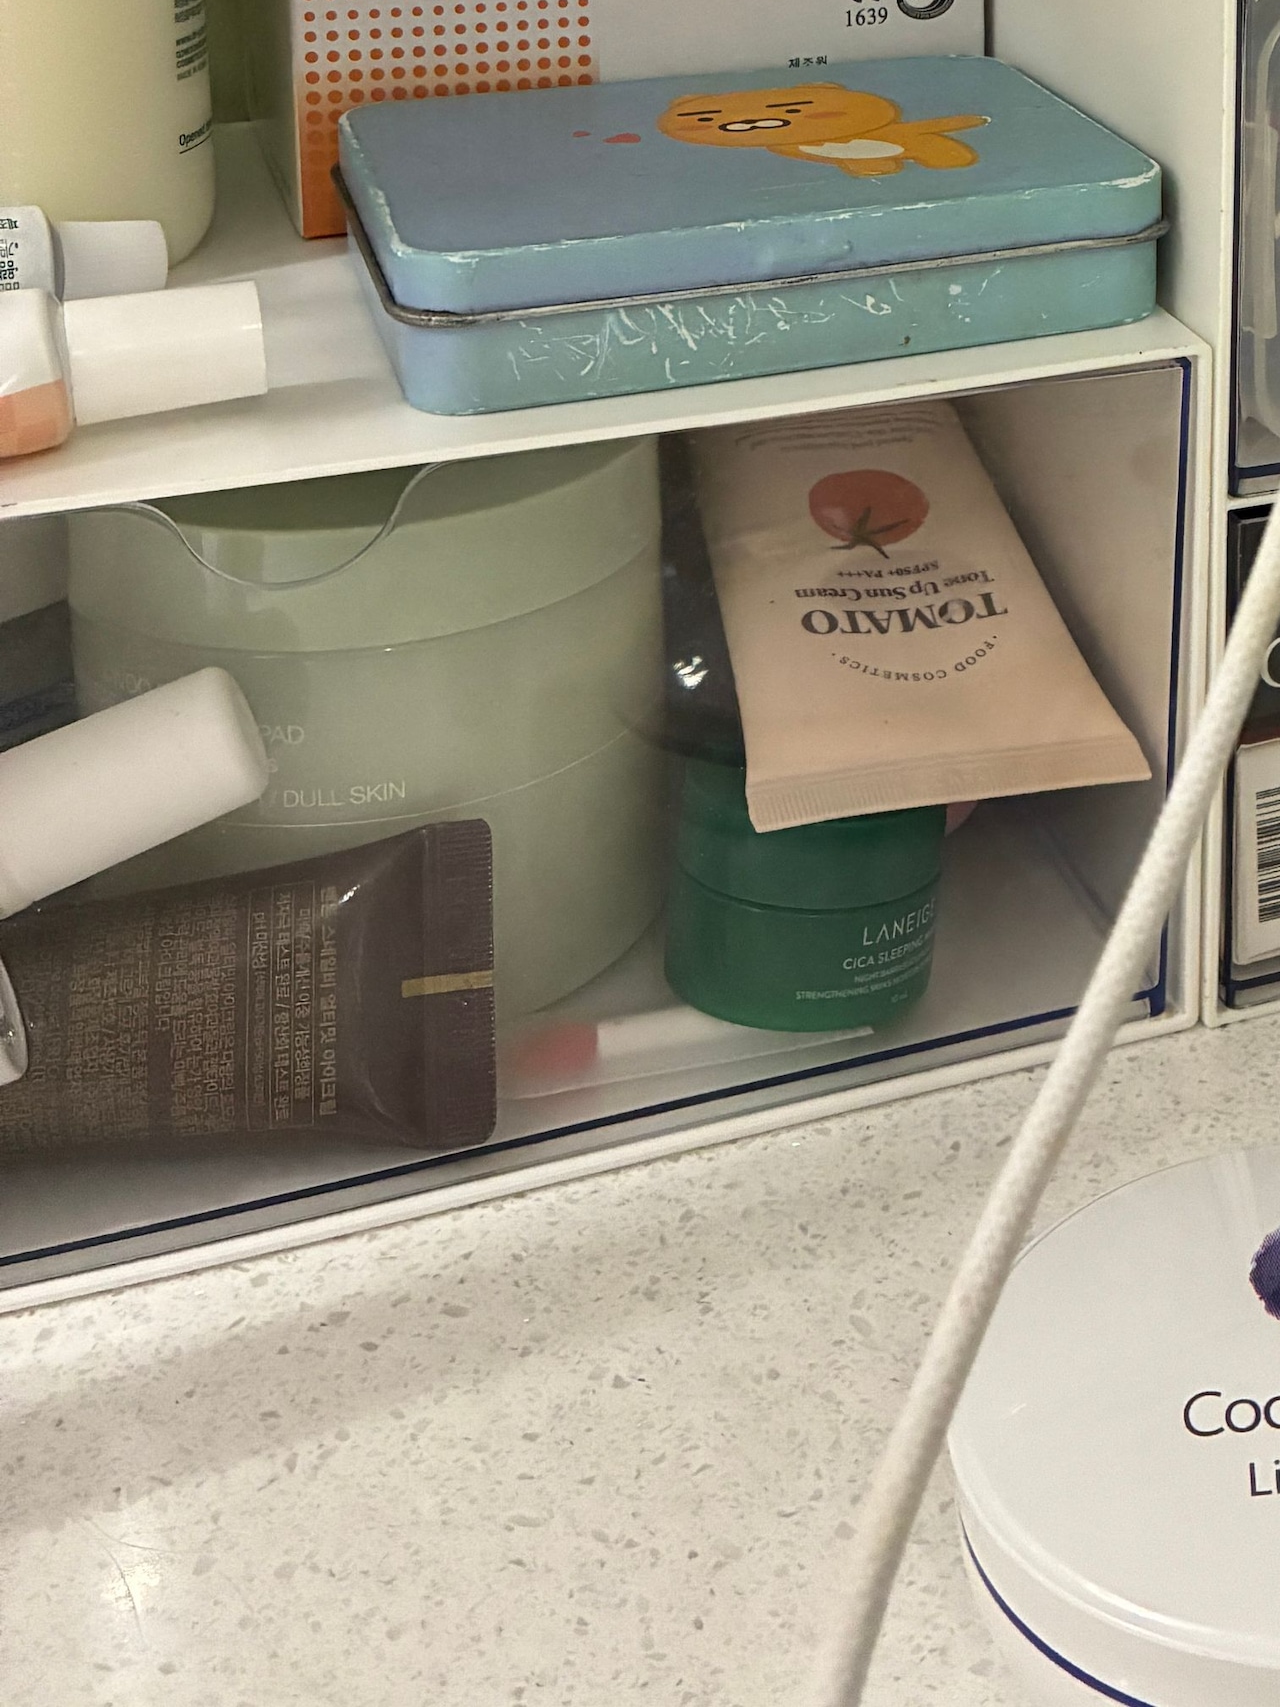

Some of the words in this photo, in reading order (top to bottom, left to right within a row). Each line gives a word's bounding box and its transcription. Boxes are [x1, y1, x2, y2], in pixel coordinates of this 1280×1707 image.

[845, 7, 888, 27] 1639
[837, 569, 883, 578] PA+++
[887, 560, 939, 577] SPF50+
[943, 570, 995, 587] Tone
[795, 588, 862, 601] Cream
[864, 587, 906, 600] Sun
[909, 581, 940, 596] Up
[801, 592, 1008, 635] TOMATO
[954, 641, 995, 672] FOOD
[839, 656, 947, 682] COSMETICS
[283, 789, 344, 808] DULL
[350, 781, 406, 805] SKIN
[842, 956, 875, 970] CICA
[878, 934, 924, 964] SLEEPING
[319, 1050, 337, 1116] 아이크림
